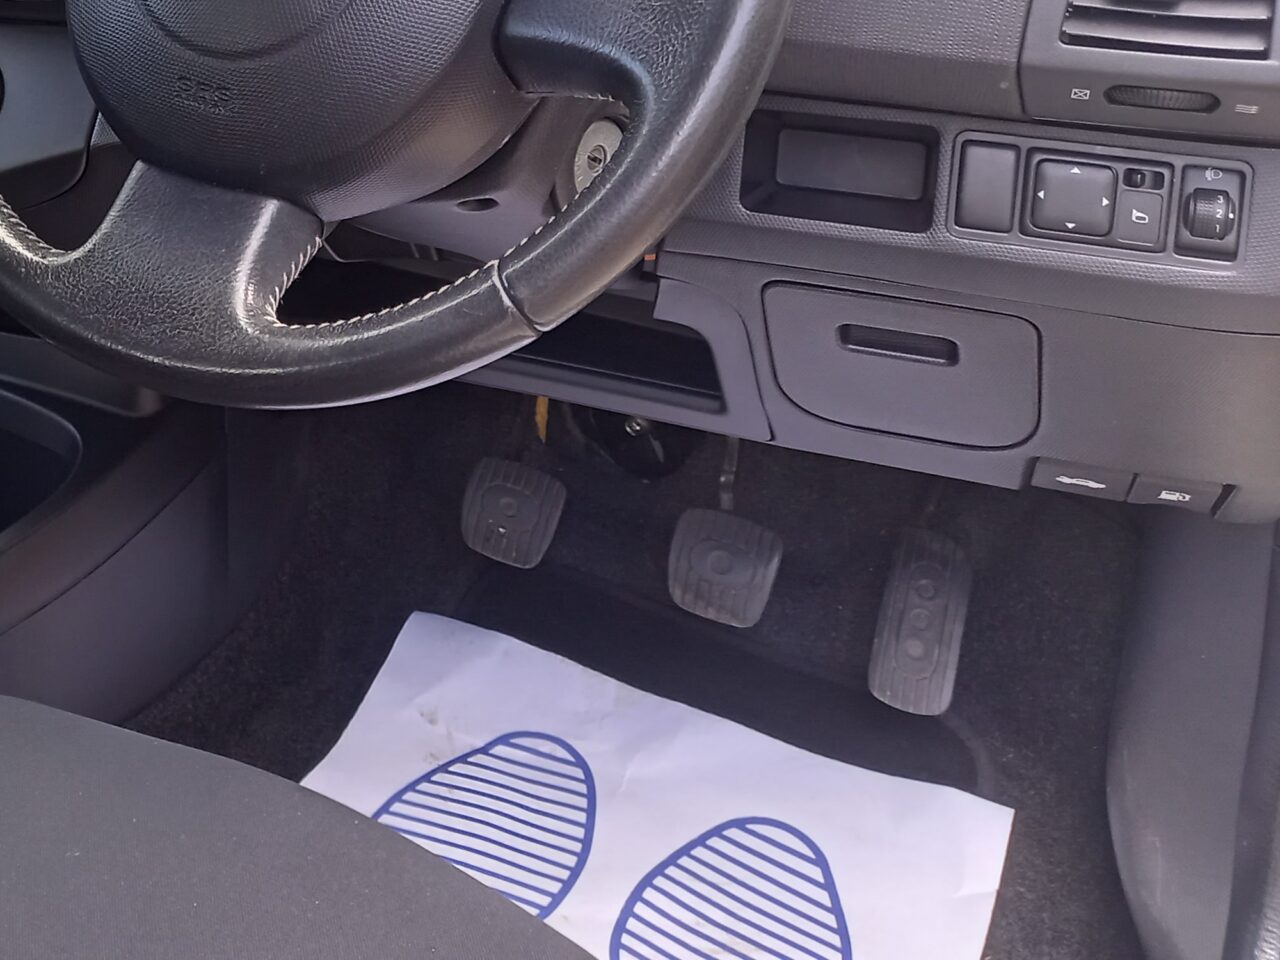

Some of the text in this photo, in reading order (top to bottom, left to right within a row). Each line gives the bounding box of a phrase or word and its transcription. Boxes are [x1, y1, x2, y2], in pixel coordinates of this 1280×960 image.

[1217, 195, 1224, 204] 3
[1215, 209, 1223, 219] 2
[1215, 224, 1220, 233] 1
